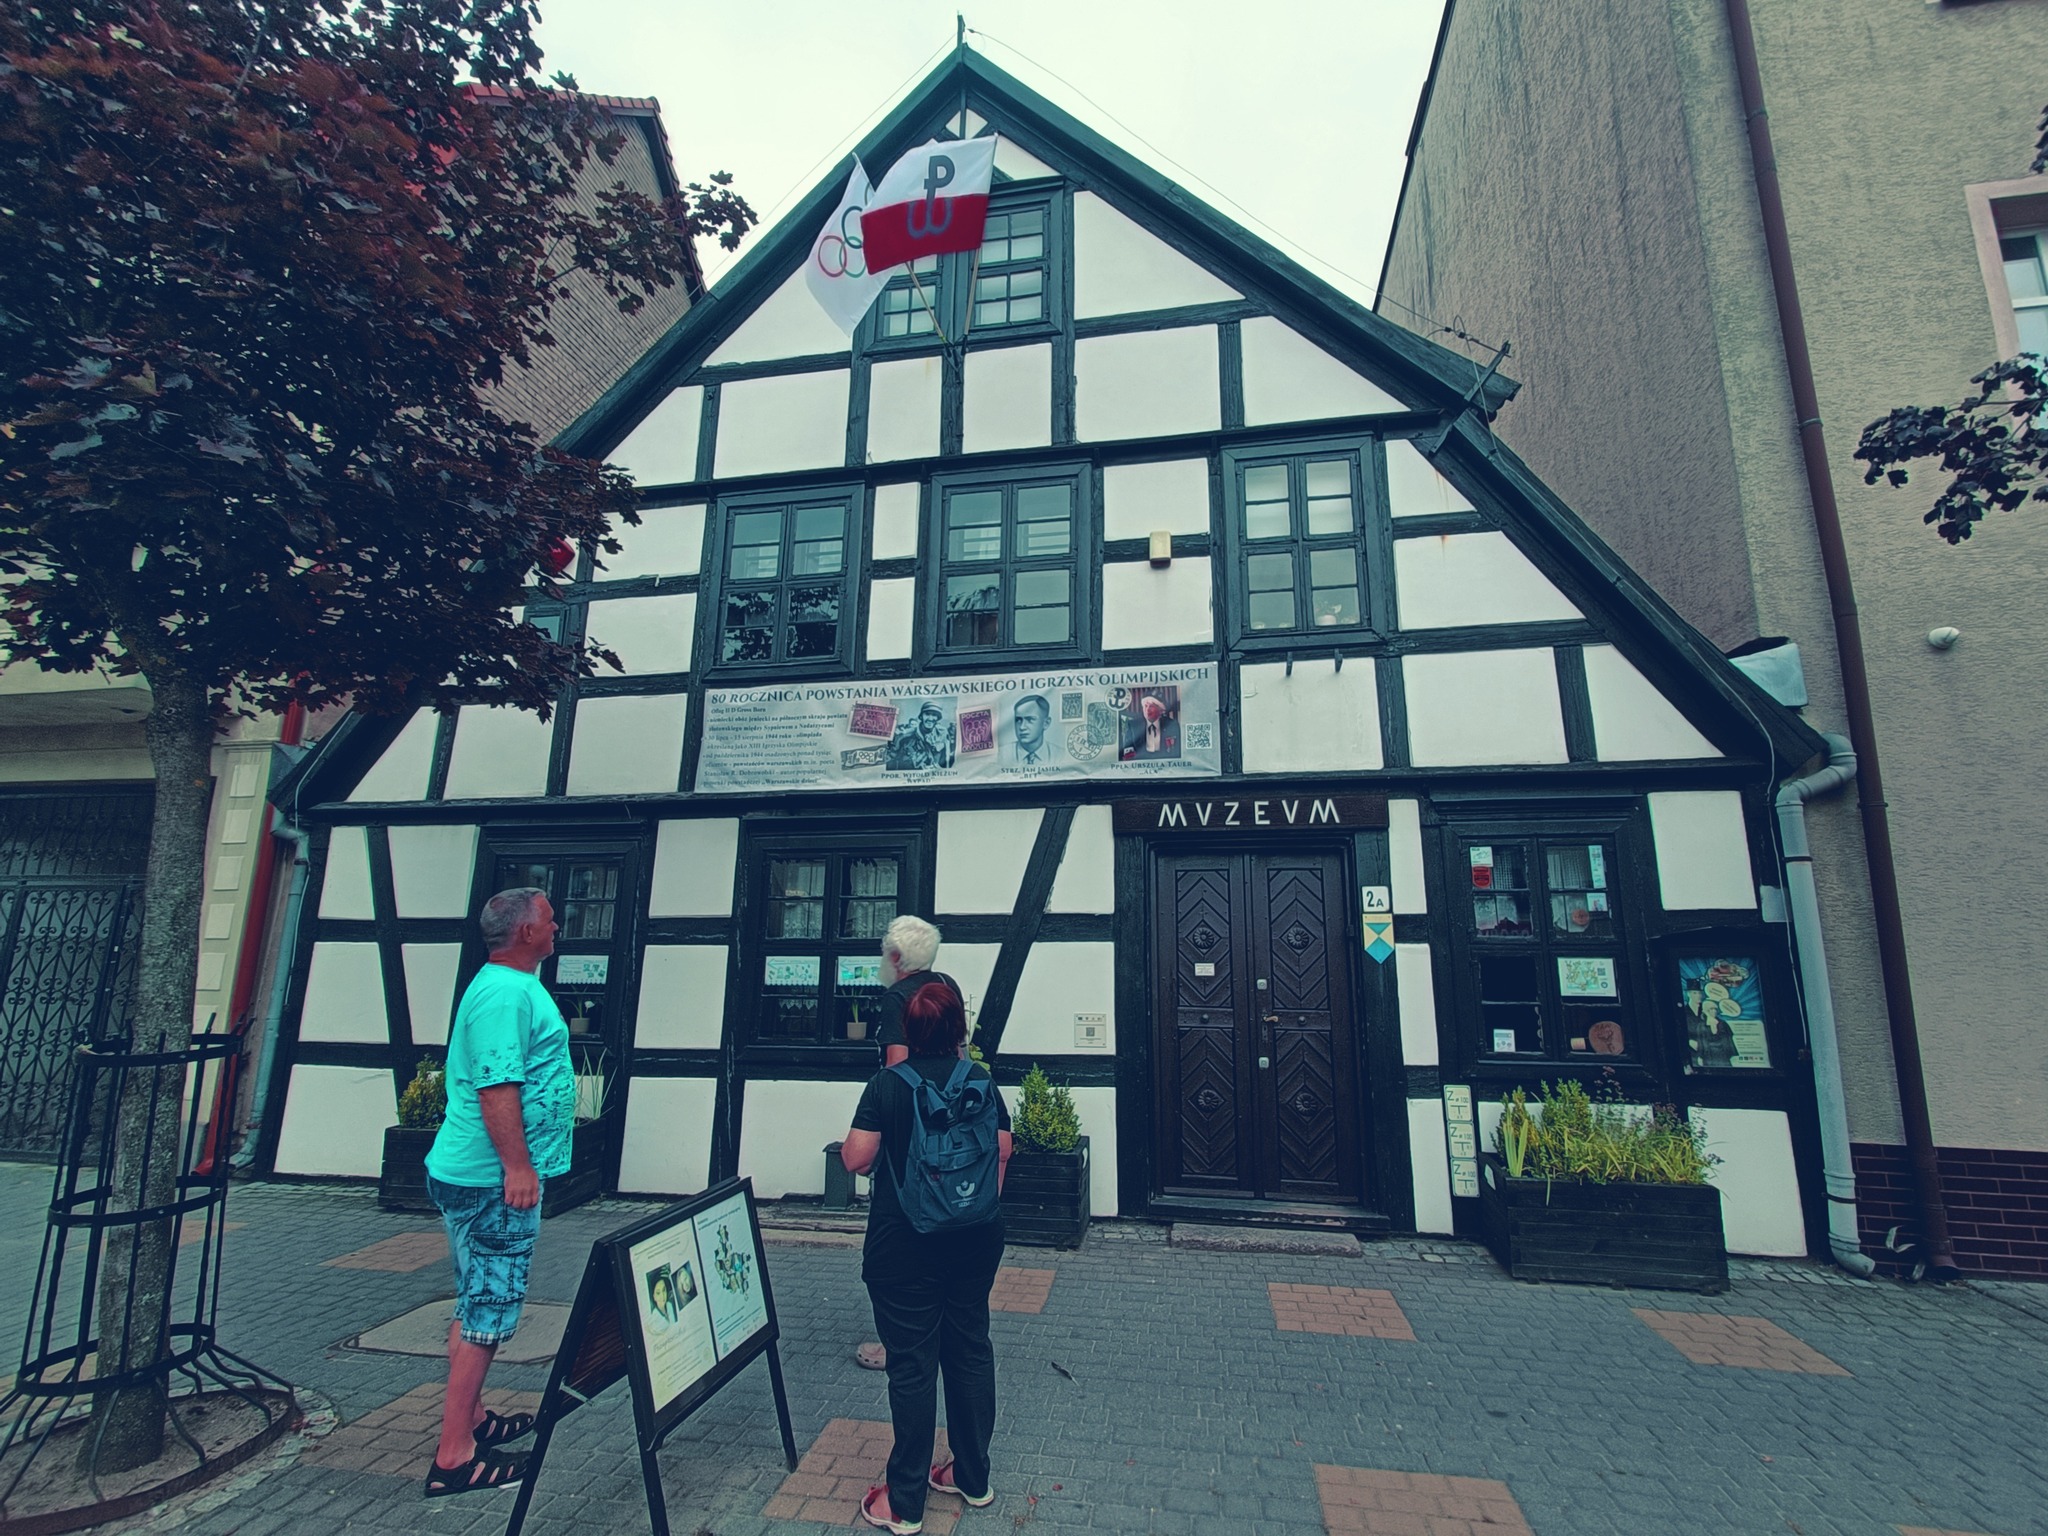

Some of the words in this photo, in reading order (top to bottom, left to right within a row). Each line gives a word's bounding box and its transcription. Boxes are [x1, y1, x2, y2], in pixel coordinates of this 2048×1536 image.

[711, 693, 727, 704] 80
[730, 690, 801, 703] ROCZNICA
[806, 686, 888, 700] POWSTANIA
[891, 680, 1016, 697] WARSZAWSKIEGO
[1021, 678, 1026, 690] I
[1030, 674, 1094, 689] IGRZYSK
[1099, 668, 1209, 685] OLIMPIJSKICH
[961, 711, 989, 720] POCZTA
[1158, 799, 1340, 827] MVZEVM
[1447, 1090, 1454, 1101] Z
[1450, 1127, 1458, 1137] Z
[1454, 1164, 1461, 1174] Z
